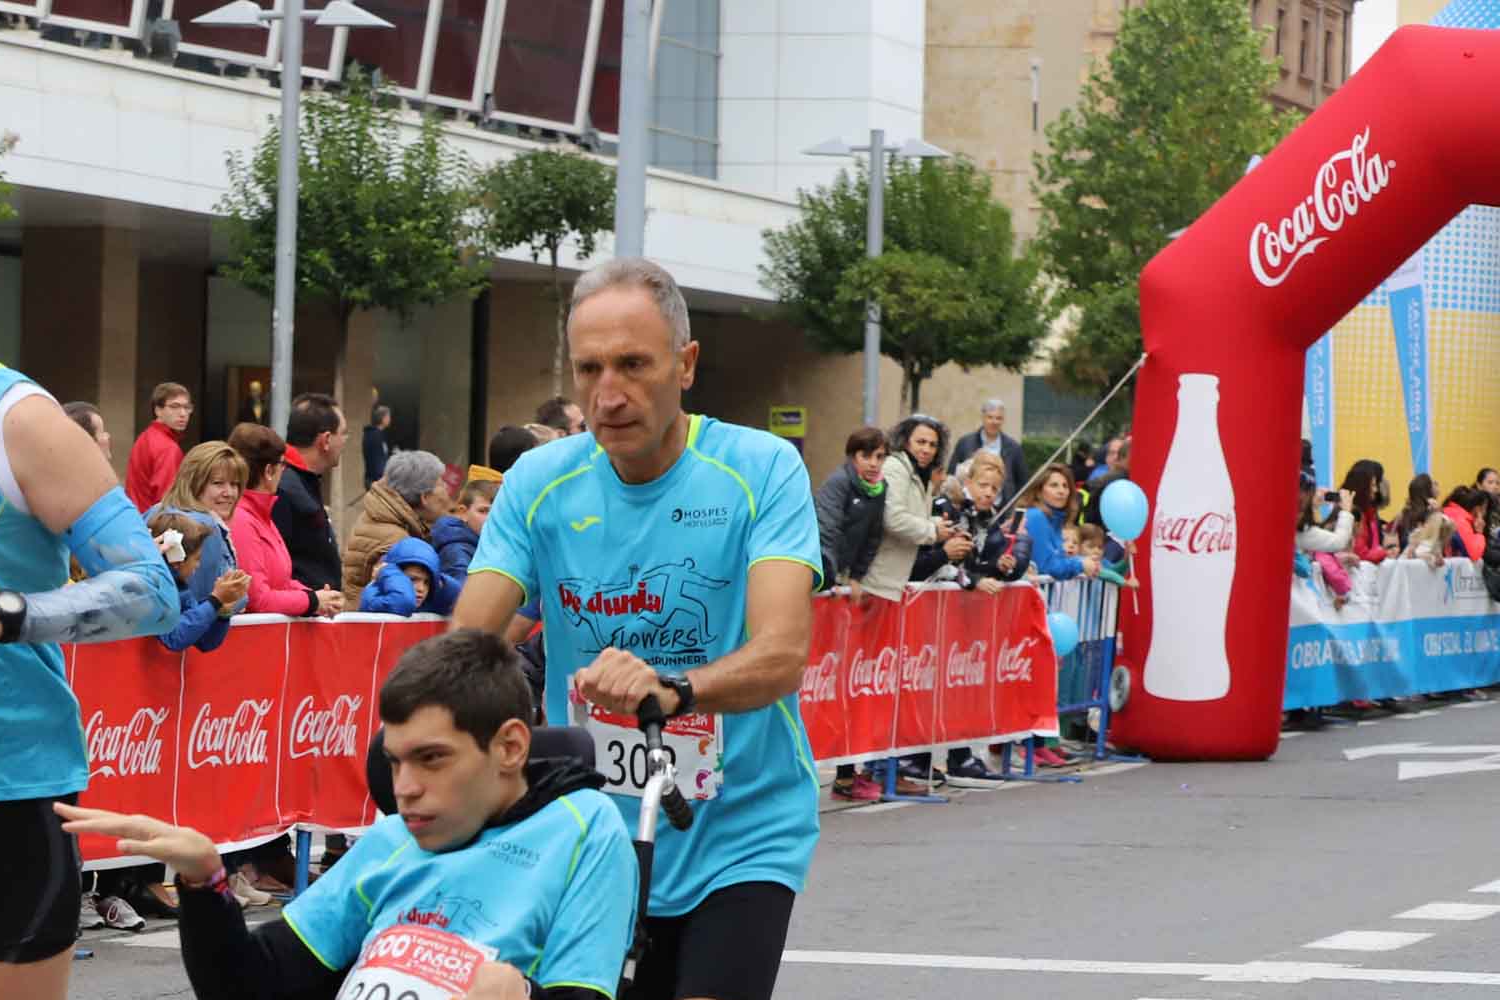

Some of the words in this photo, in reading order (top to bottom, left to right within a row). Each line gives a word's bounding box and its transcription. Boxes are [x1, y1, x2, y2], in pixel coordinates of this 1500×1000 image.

[1250, 126, 1389, 287] Coca-Cola
[609, 626, 699, 648] FLOWERS
[187, 698, 273, 769] Coca-Cola
[289, 695, 363, 759] Coca-Cola
